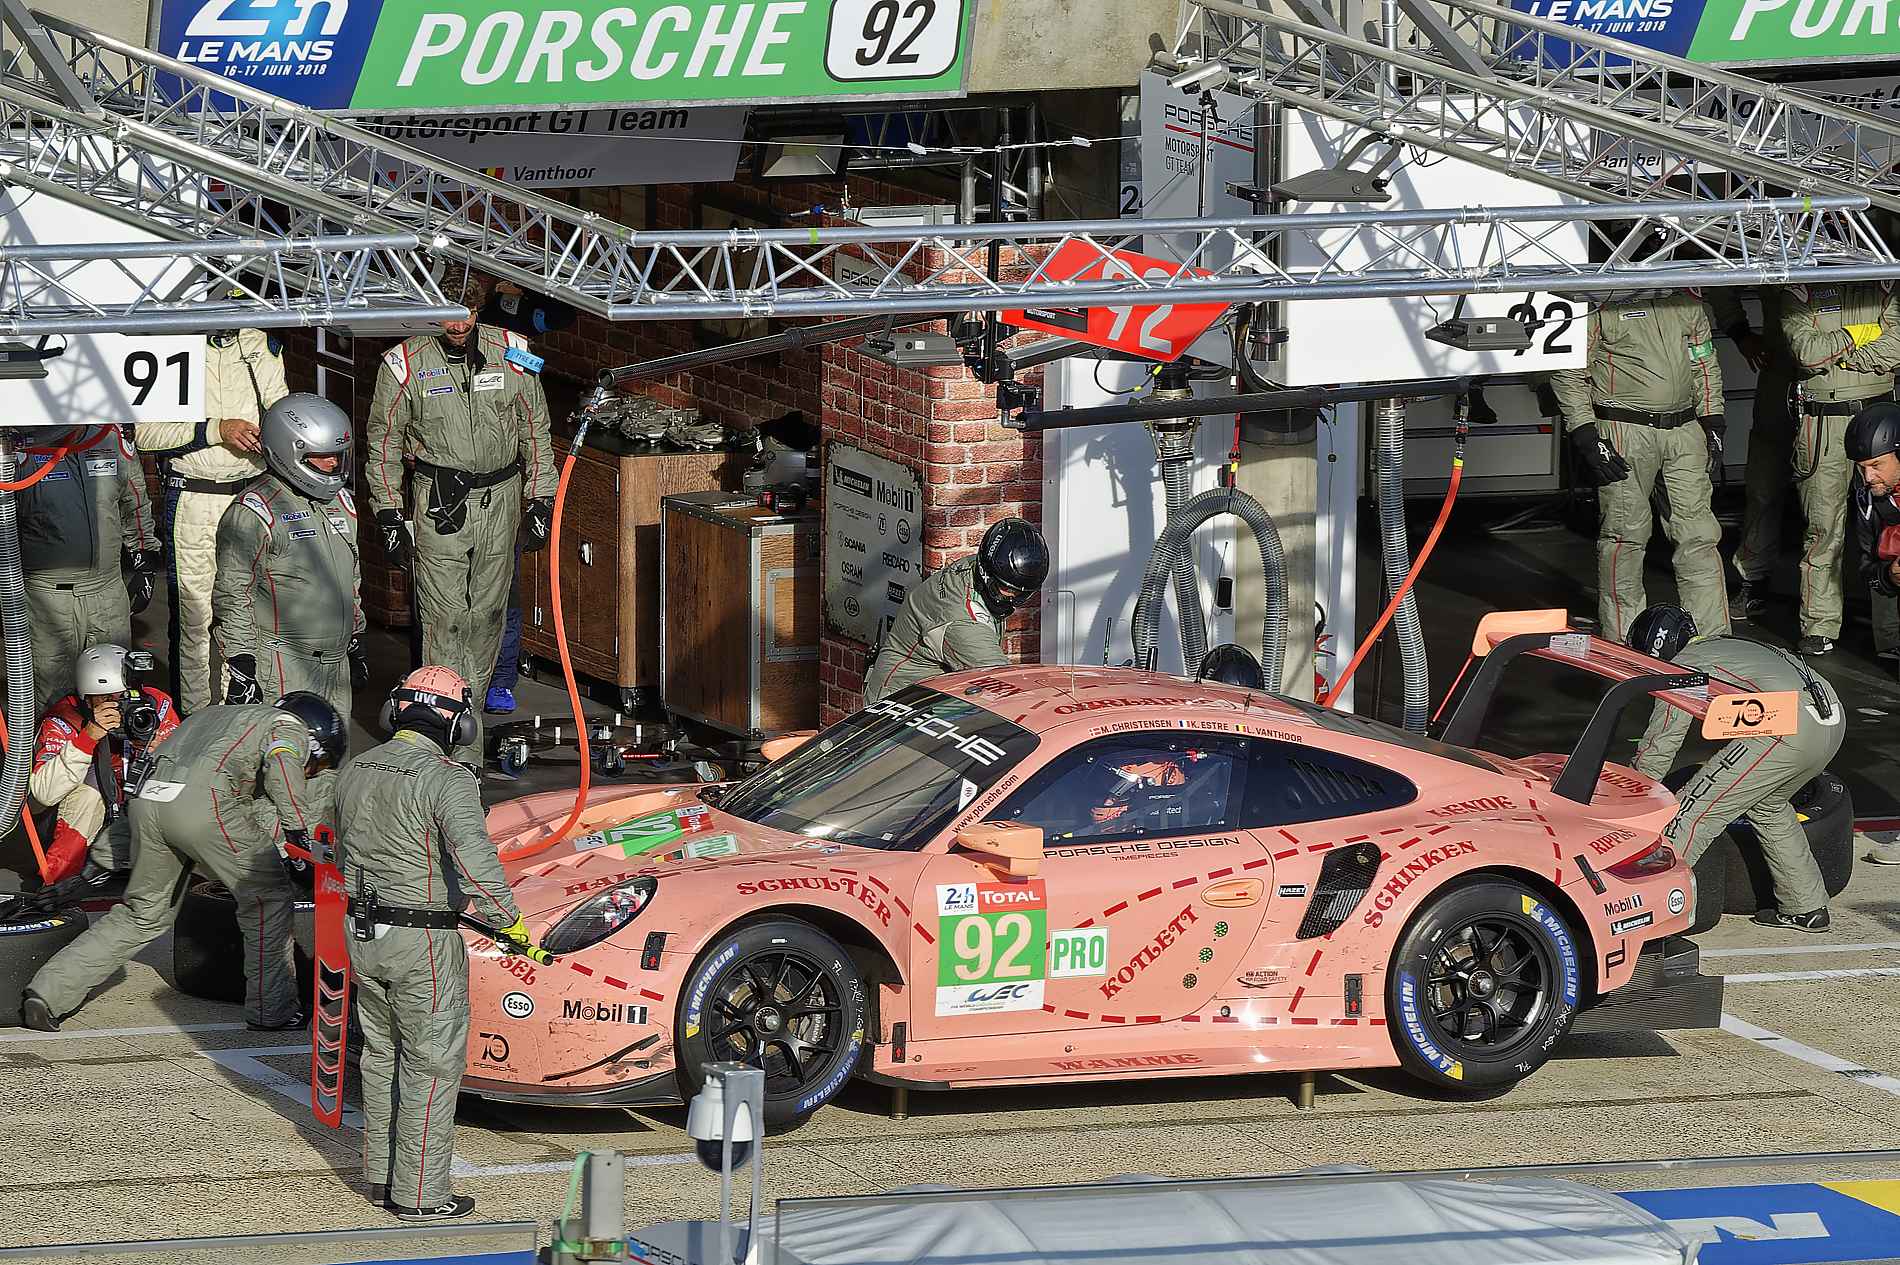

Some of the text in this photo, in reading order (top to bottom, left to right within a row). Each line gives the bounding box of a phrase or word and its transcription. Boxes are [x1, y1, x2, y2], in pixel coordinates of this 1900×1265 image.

[1529, 0, 1674, 21] LE MANS
[1729, 0, 1900, 41] POR
[856, 0, 937, 66] 92
[1606, 22, 1633, 33] JUIN
[1636, 21, 1667, 32] 2018
[177, 40, 335, 63] LE MANS
[396, 1, 805, 87] PORSCHE
[223, 63, 328, 76] 16-17 JUIN 2018
[607, 108, 689, 132] Team
[1165, 103, 1253, 142] PORSCHE
[1165, 136, 1214, 163] MOTORSPRT
[514, 164, 597, 182] Vanthoor
[1165, 155, 1195, 177] GT TEAM
[124, 351, 190, 406] 91
[479, 376, 503, 384] WEC
[877, 479, 904, 511] Mobil
[844, 536, 866, 554] SCANIA
[841, 560, 863, 580] OSRAM
[882, 551, 910, 574] RECARO
[1731, 699, 1765, 728] 70
[1100, 725, 1112, 735] M.
[1112, 719, 1172, 733] CHRISTENSEN
[1191, 720, 1200, 730] K.
[1201, 720, 1229, 731] ESTRE
[1255, 726, 1303, 743] VANTHOOR
[1722, 729, 1773, 737] PORSCHE
[353, 761, 418, 777] PORSCHE
[951, 773, 1019, 835] www.porsche.com
[1425, 795, 1518, 818] LENDE
[1044, 837, 1240, 860] PORSCHE DESIGN
[1112, 851, 1179, 862] TIMEPIECES
[1278, 887, 1307, 895] HAZET
[1363, 841, 1479, 929] SCHINKEN
[736, 877, 892, 928] SCHULTER
[980, 890, 1041, 905] TOTAL
[1604, 896, 1632, 917] Mobil
[953, 913, 1032, 981] 92
[1053, 935, 1105, 971] PRO
[1099, 903, 1199, 1001] KOTLETT
[1544, 916, 1578, 998] MICHELIN
[690, 946, 735, 1013] MICHELIN
[967, 984, 1030, 1003] WEC
[562, 999, 645, 1024] Mobil 1
[1402, 981, 1440, 1061] MICHELIN
[480, 1032, 510, 1063] 70
[473, 1062, 520, 1074] PORSCHE
[1049, 1053, 1204, 1071] WAMME
